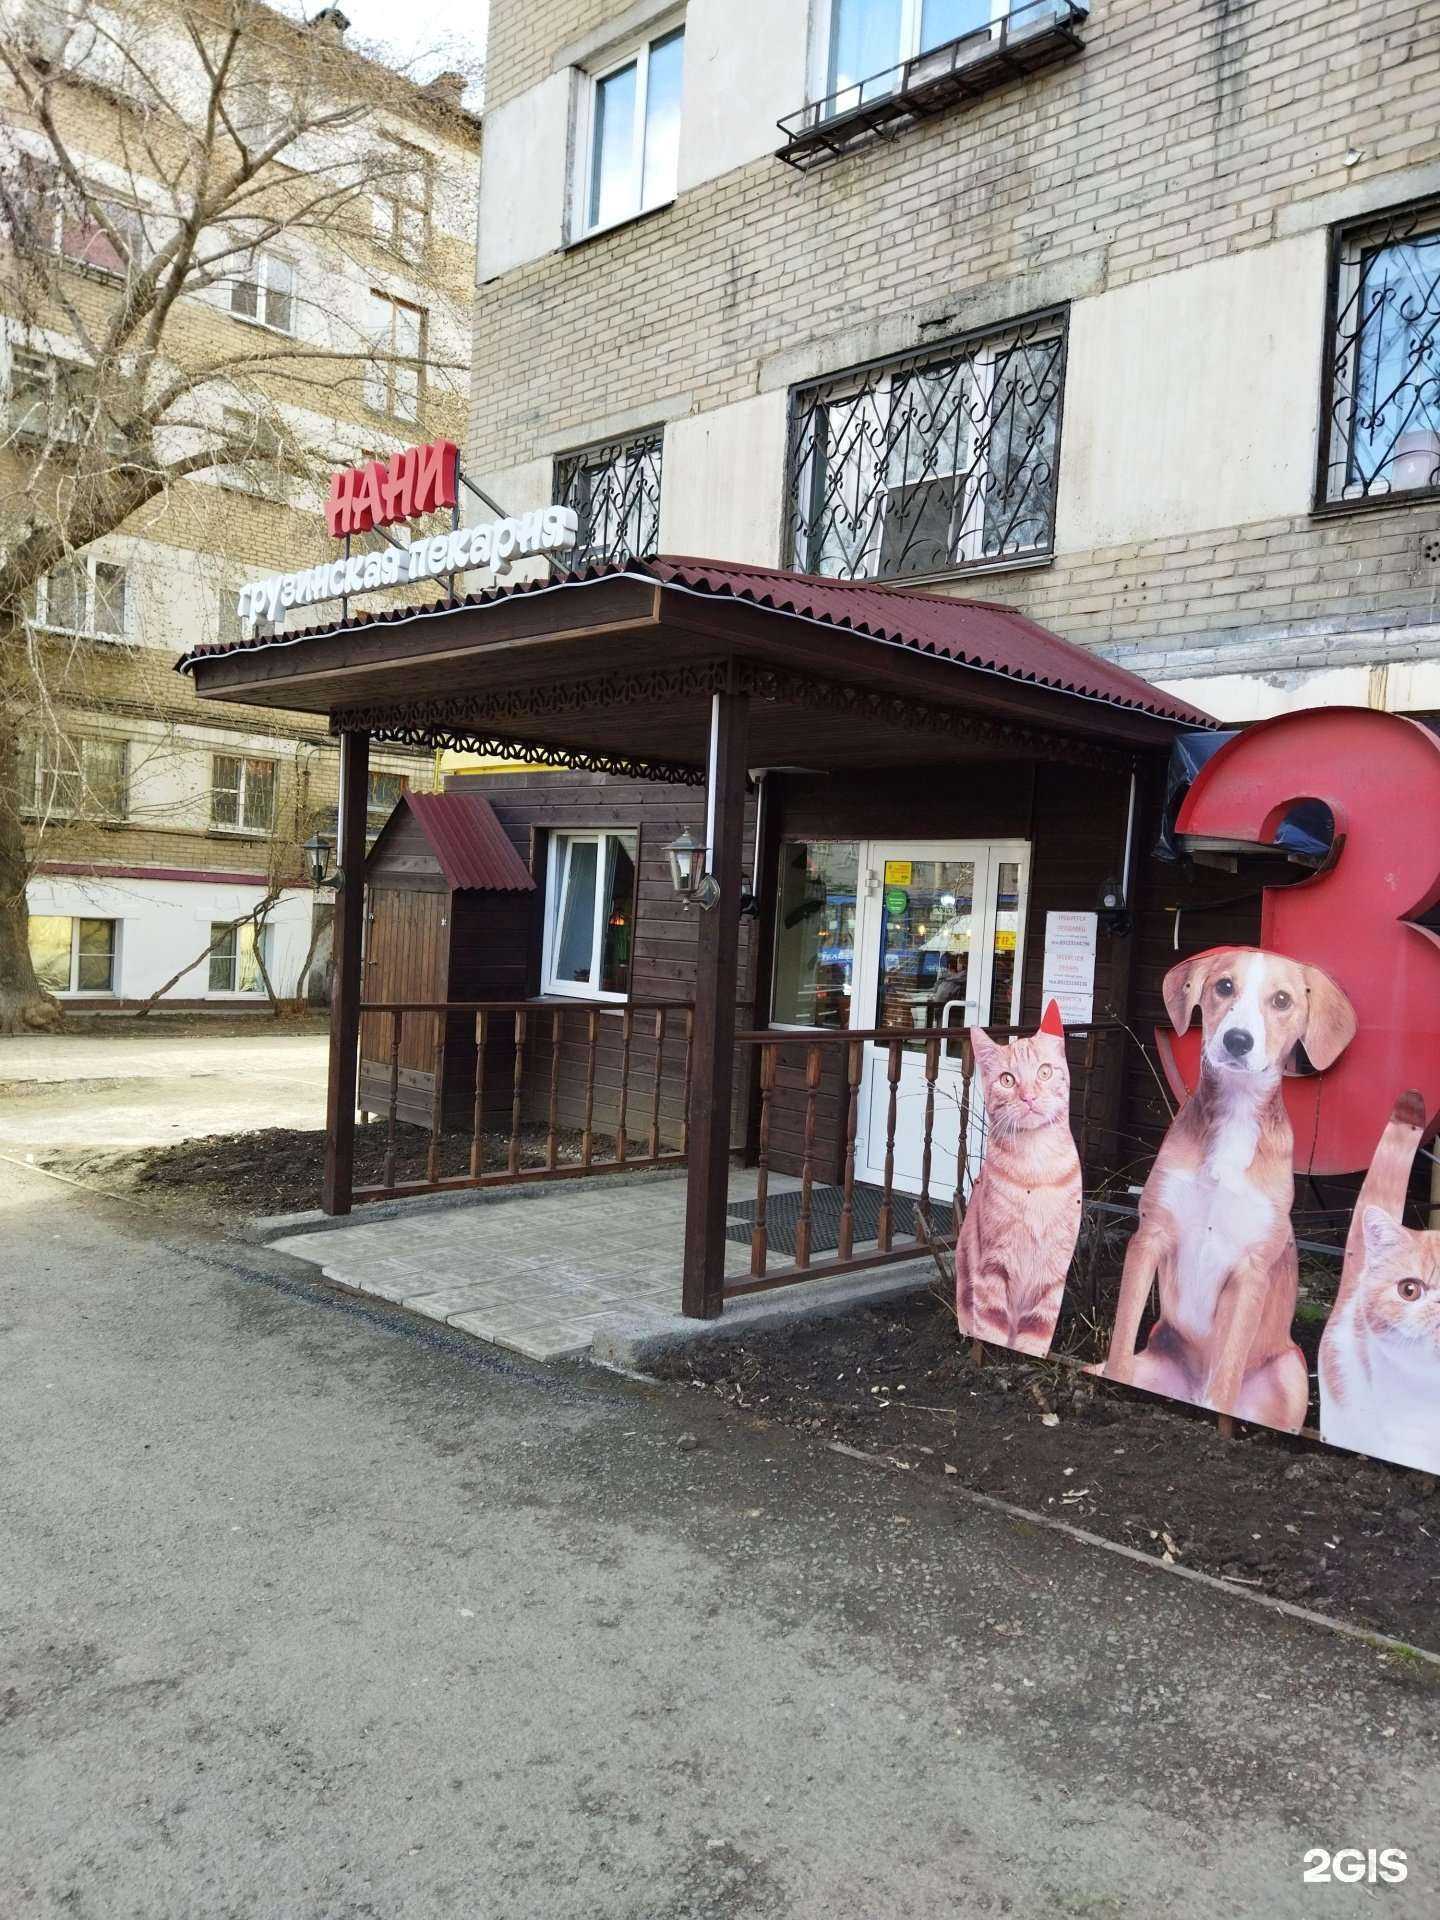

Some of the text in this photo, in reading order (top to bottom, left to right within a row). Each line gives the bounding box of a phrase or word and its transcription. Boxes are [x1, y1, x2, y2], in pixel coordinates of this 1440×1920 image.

[324, 439, 459, 538] НАНИ
[237, 505, 579, 626] грузинская пекарня
